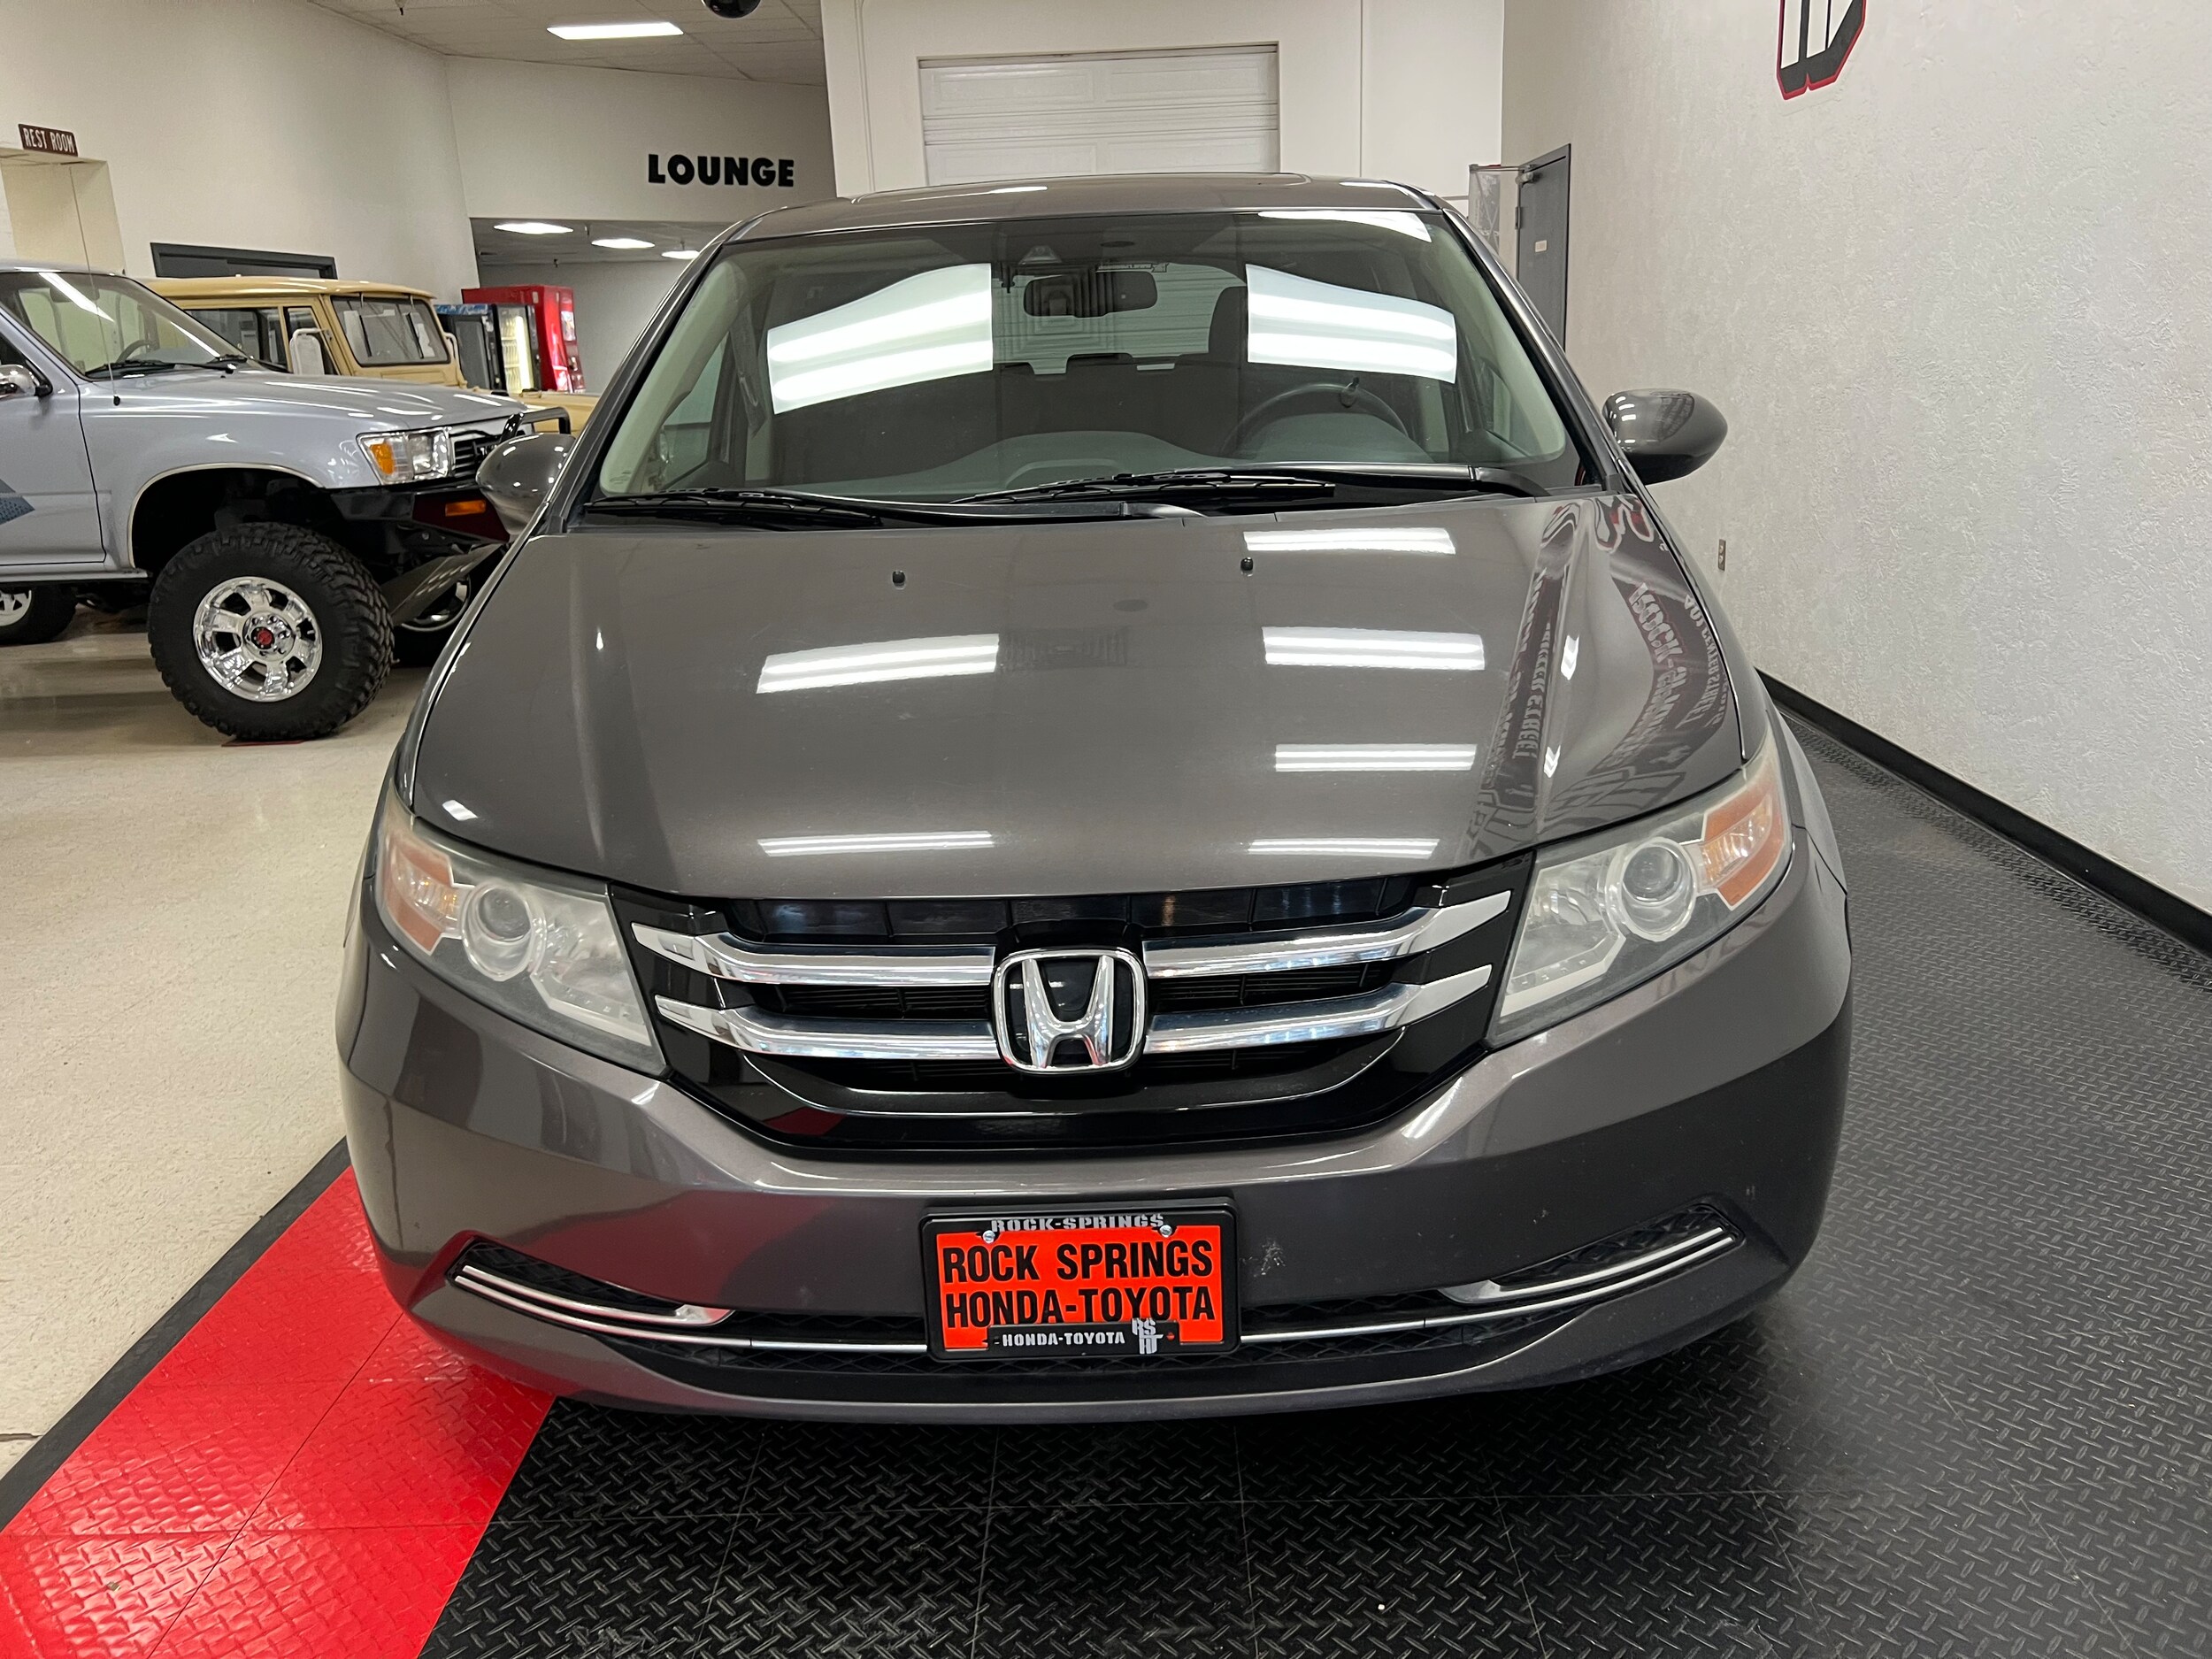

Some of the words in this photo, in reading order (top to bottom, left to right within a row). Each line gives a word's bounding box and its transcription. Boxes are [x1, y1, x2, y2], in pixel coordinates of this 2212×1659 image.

[22, 127, 48, 150] REST
[50, 131, 75, 153] ROOM
[648, 153, 795, 188] LOUNGE
[990, 1213, 1164, 1233] ROCK-SPRINGS
[942, 1244, 1041, 1283] ROCK
[1056, 1240, 1213, 1280] SPRINGS
[945, 1286, 1216, 1328] HONDA-TOYOTA
[1002, 1331, 1125, 1347] HONDA-TOYOTA
